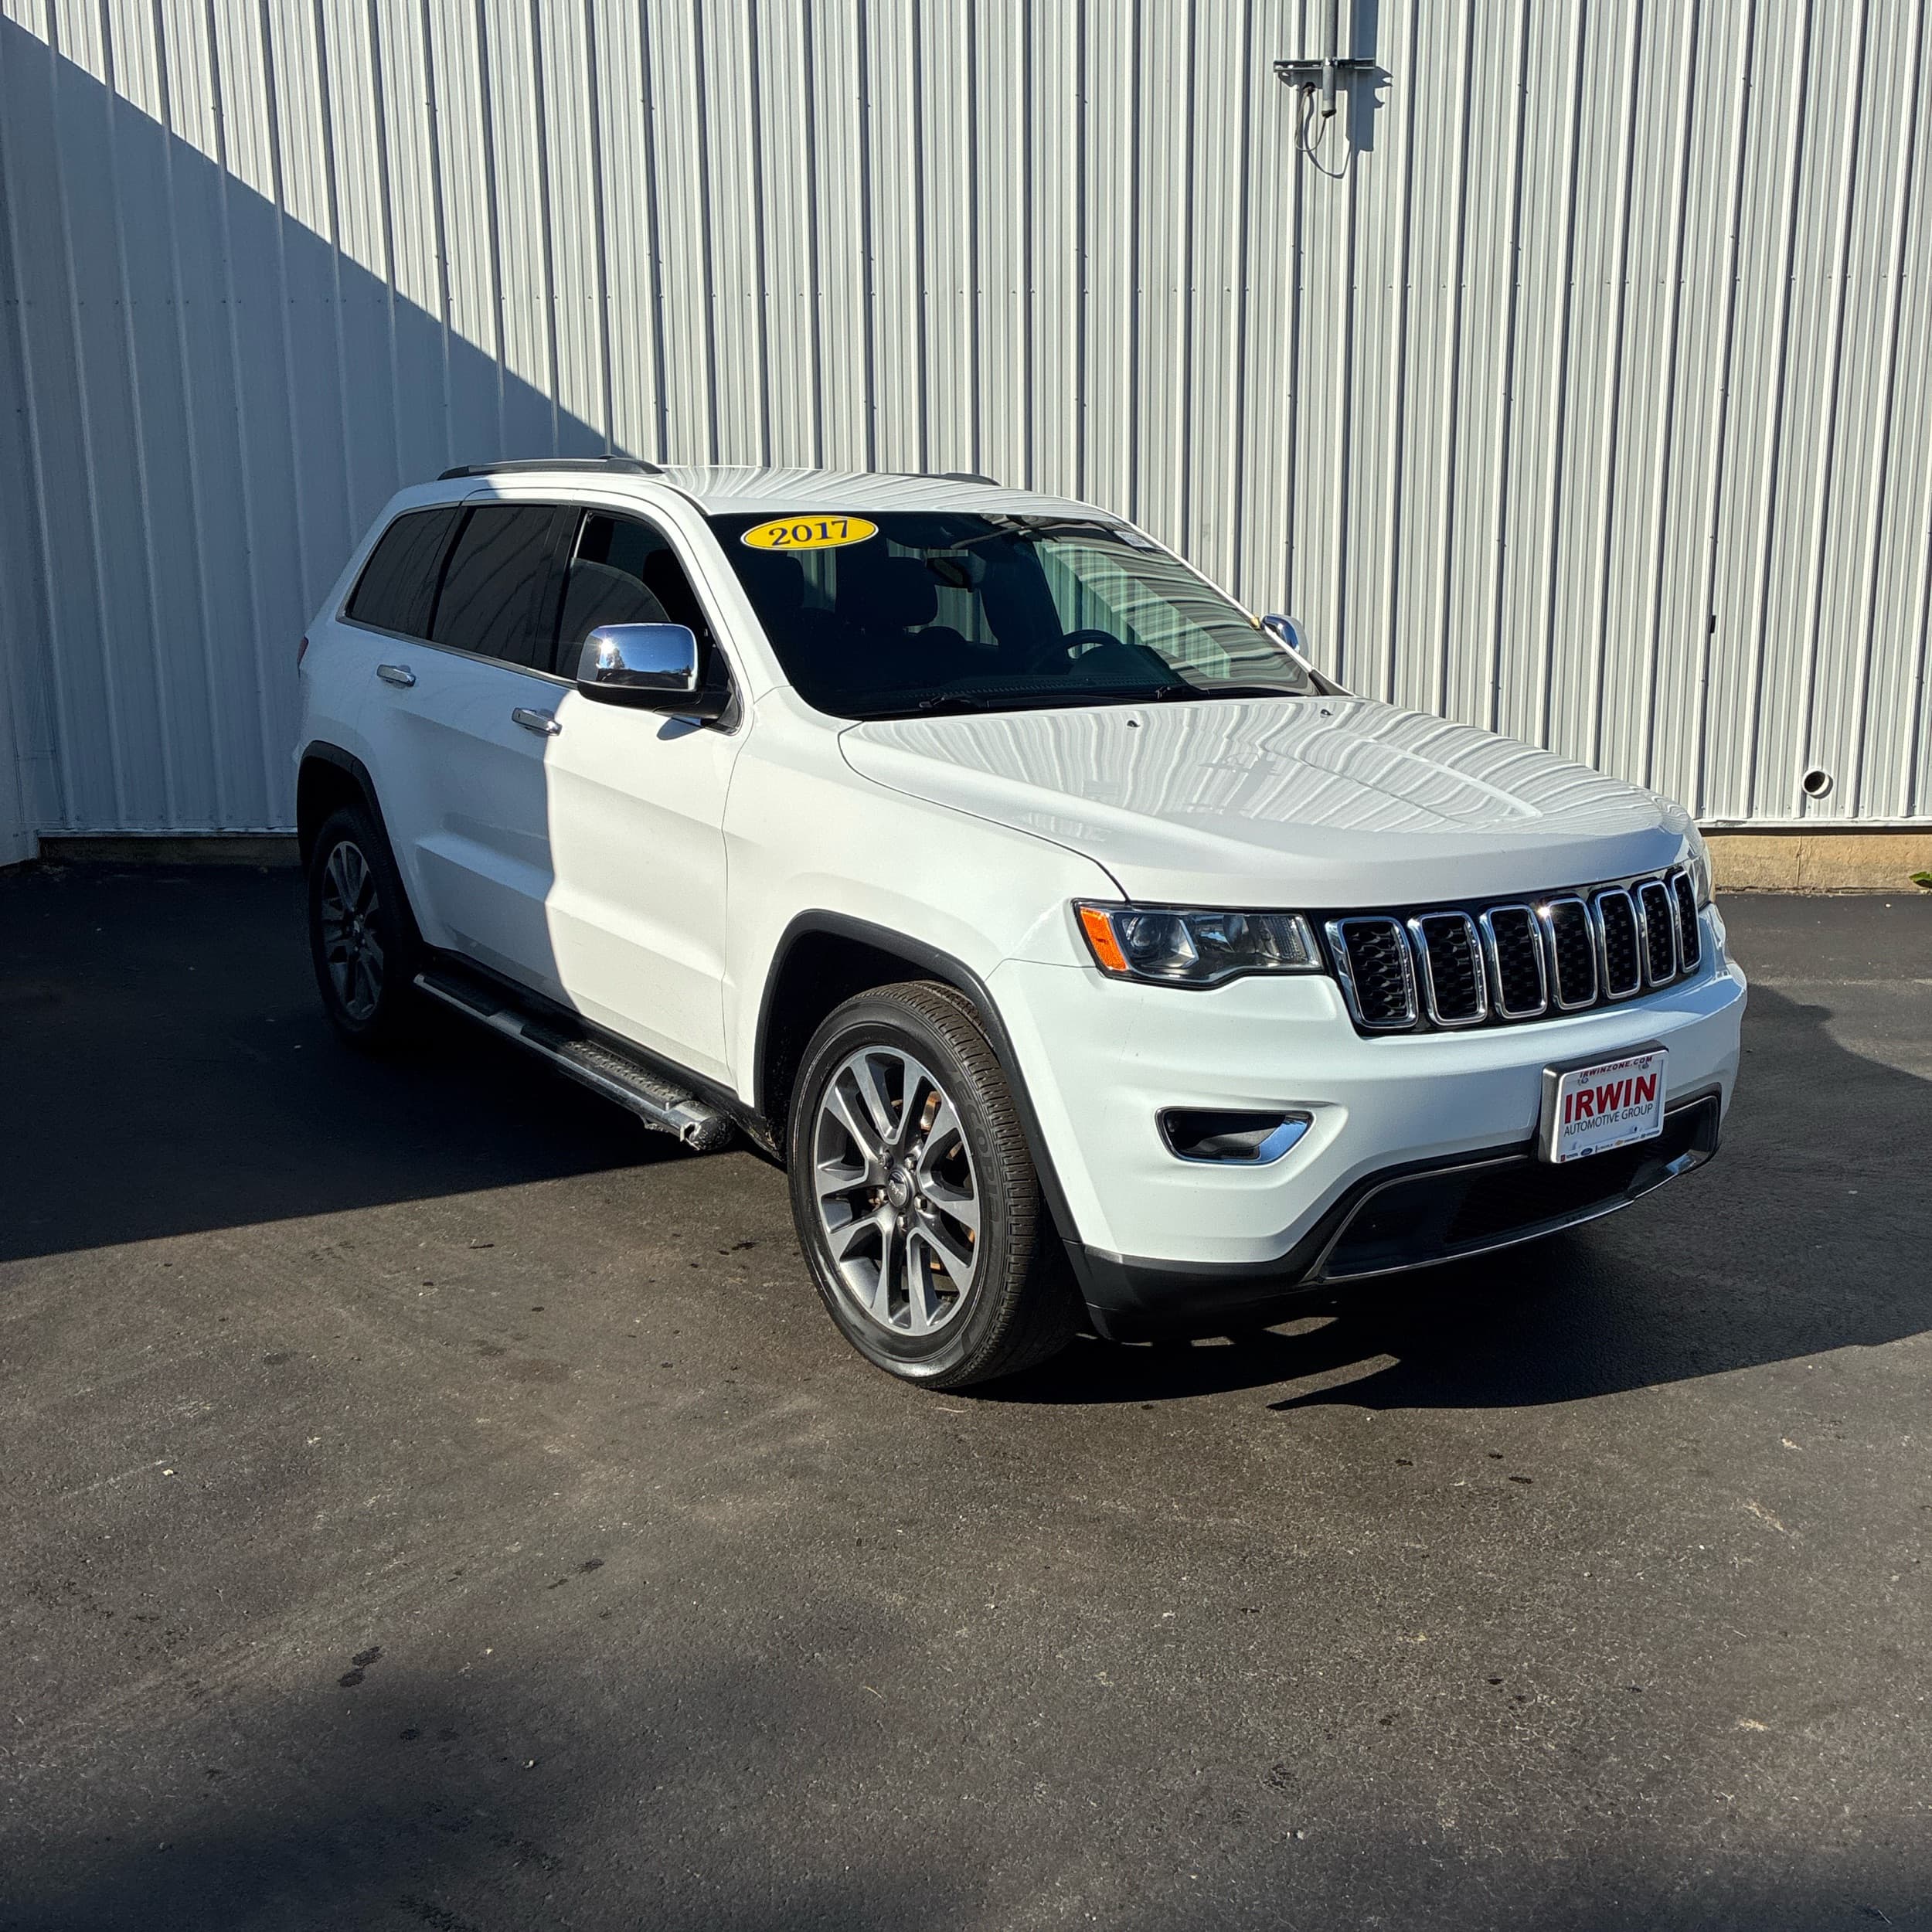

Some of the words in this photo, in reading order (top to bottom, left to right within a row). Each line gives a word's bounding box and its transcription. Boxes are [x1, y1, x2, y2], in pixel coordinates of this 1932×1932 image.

[769, 520, 848, 546] 2017
[1580, 1056, 1652, 1078] IRWINZONE.COM
[1564, 1073, 1657, 1124] IRWIN
[1563, 1111, 1620, 1137] AUTOMOTIVE
[1621, 1103, 1653, 1120] GROUP
